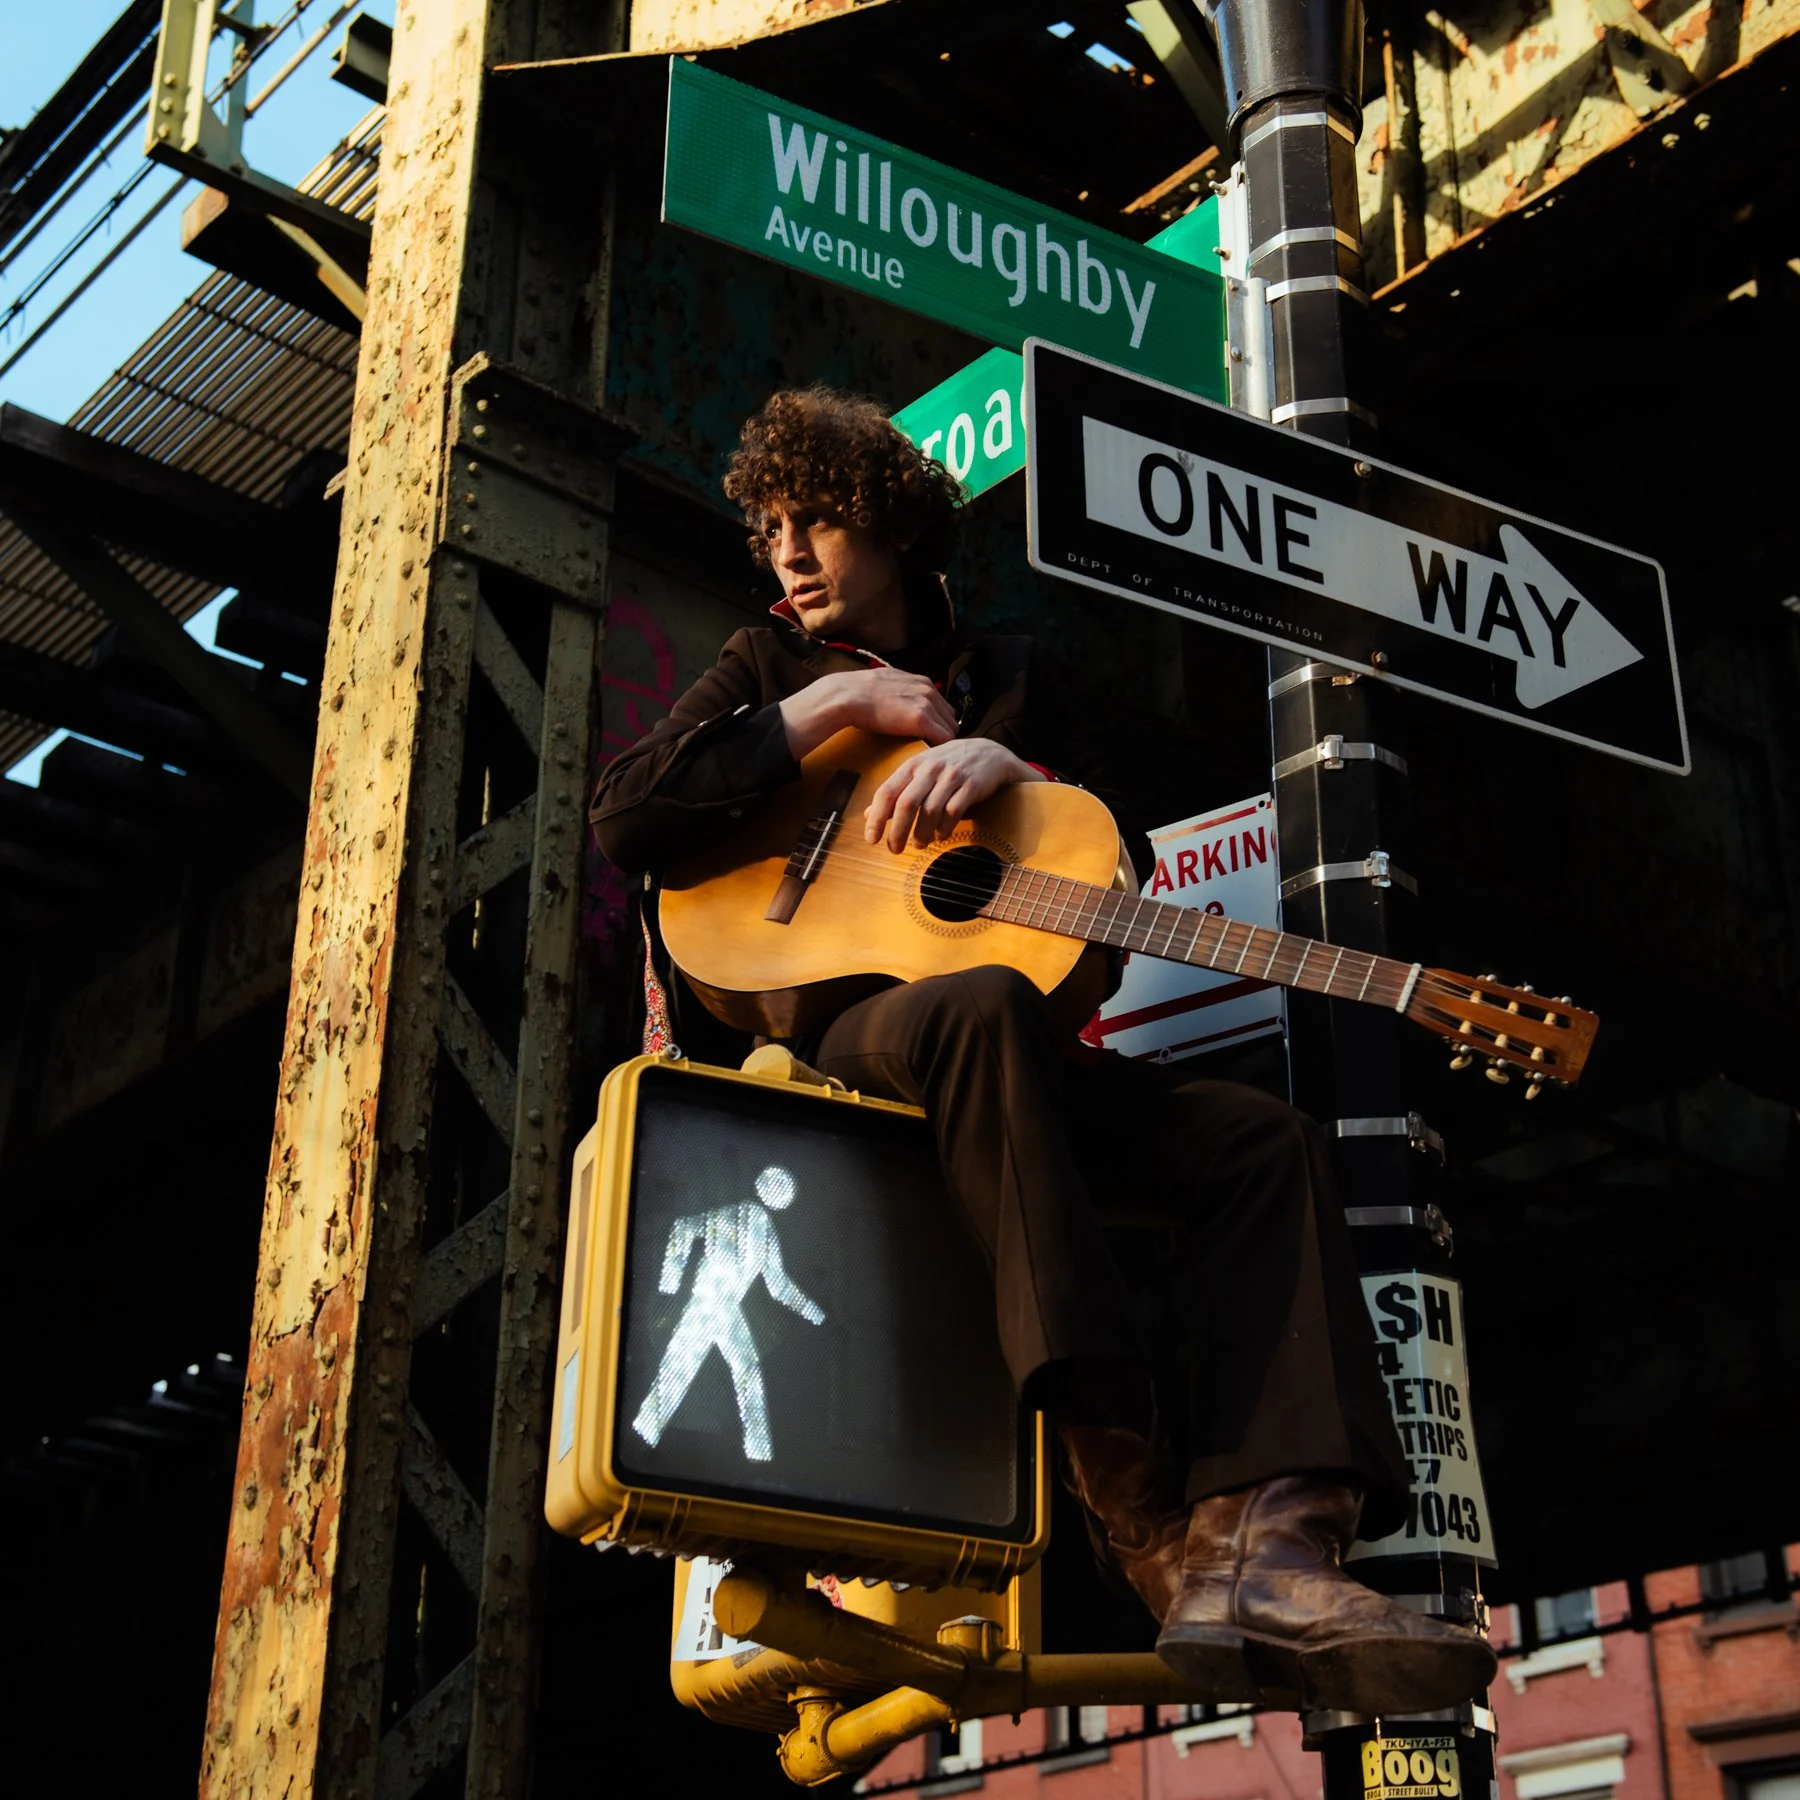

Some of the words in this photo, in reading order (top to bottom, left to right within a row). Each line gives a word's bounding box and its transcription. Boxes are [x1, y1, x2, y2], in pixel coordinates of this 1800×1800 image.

[764, 205, 906, 289] Avenue
[767, 112, 1157, 350] Willoughby
[920, 388, 1026, 483] roa
[1066, 551, 1112, 575] DEPT
[1131, 572, 1154, 587] OF
[1172, 585, 1324, 642] TRANSPORTATION
[1138, 452, 1325, 586] ONE
[1406, 541, 1581, 669] WAY
[1151, 826, 1275, 897] ARKIN
[1388, 1787, 1412, 1797] STREET
[1414, 1786, 1435, 1796] BULLY
